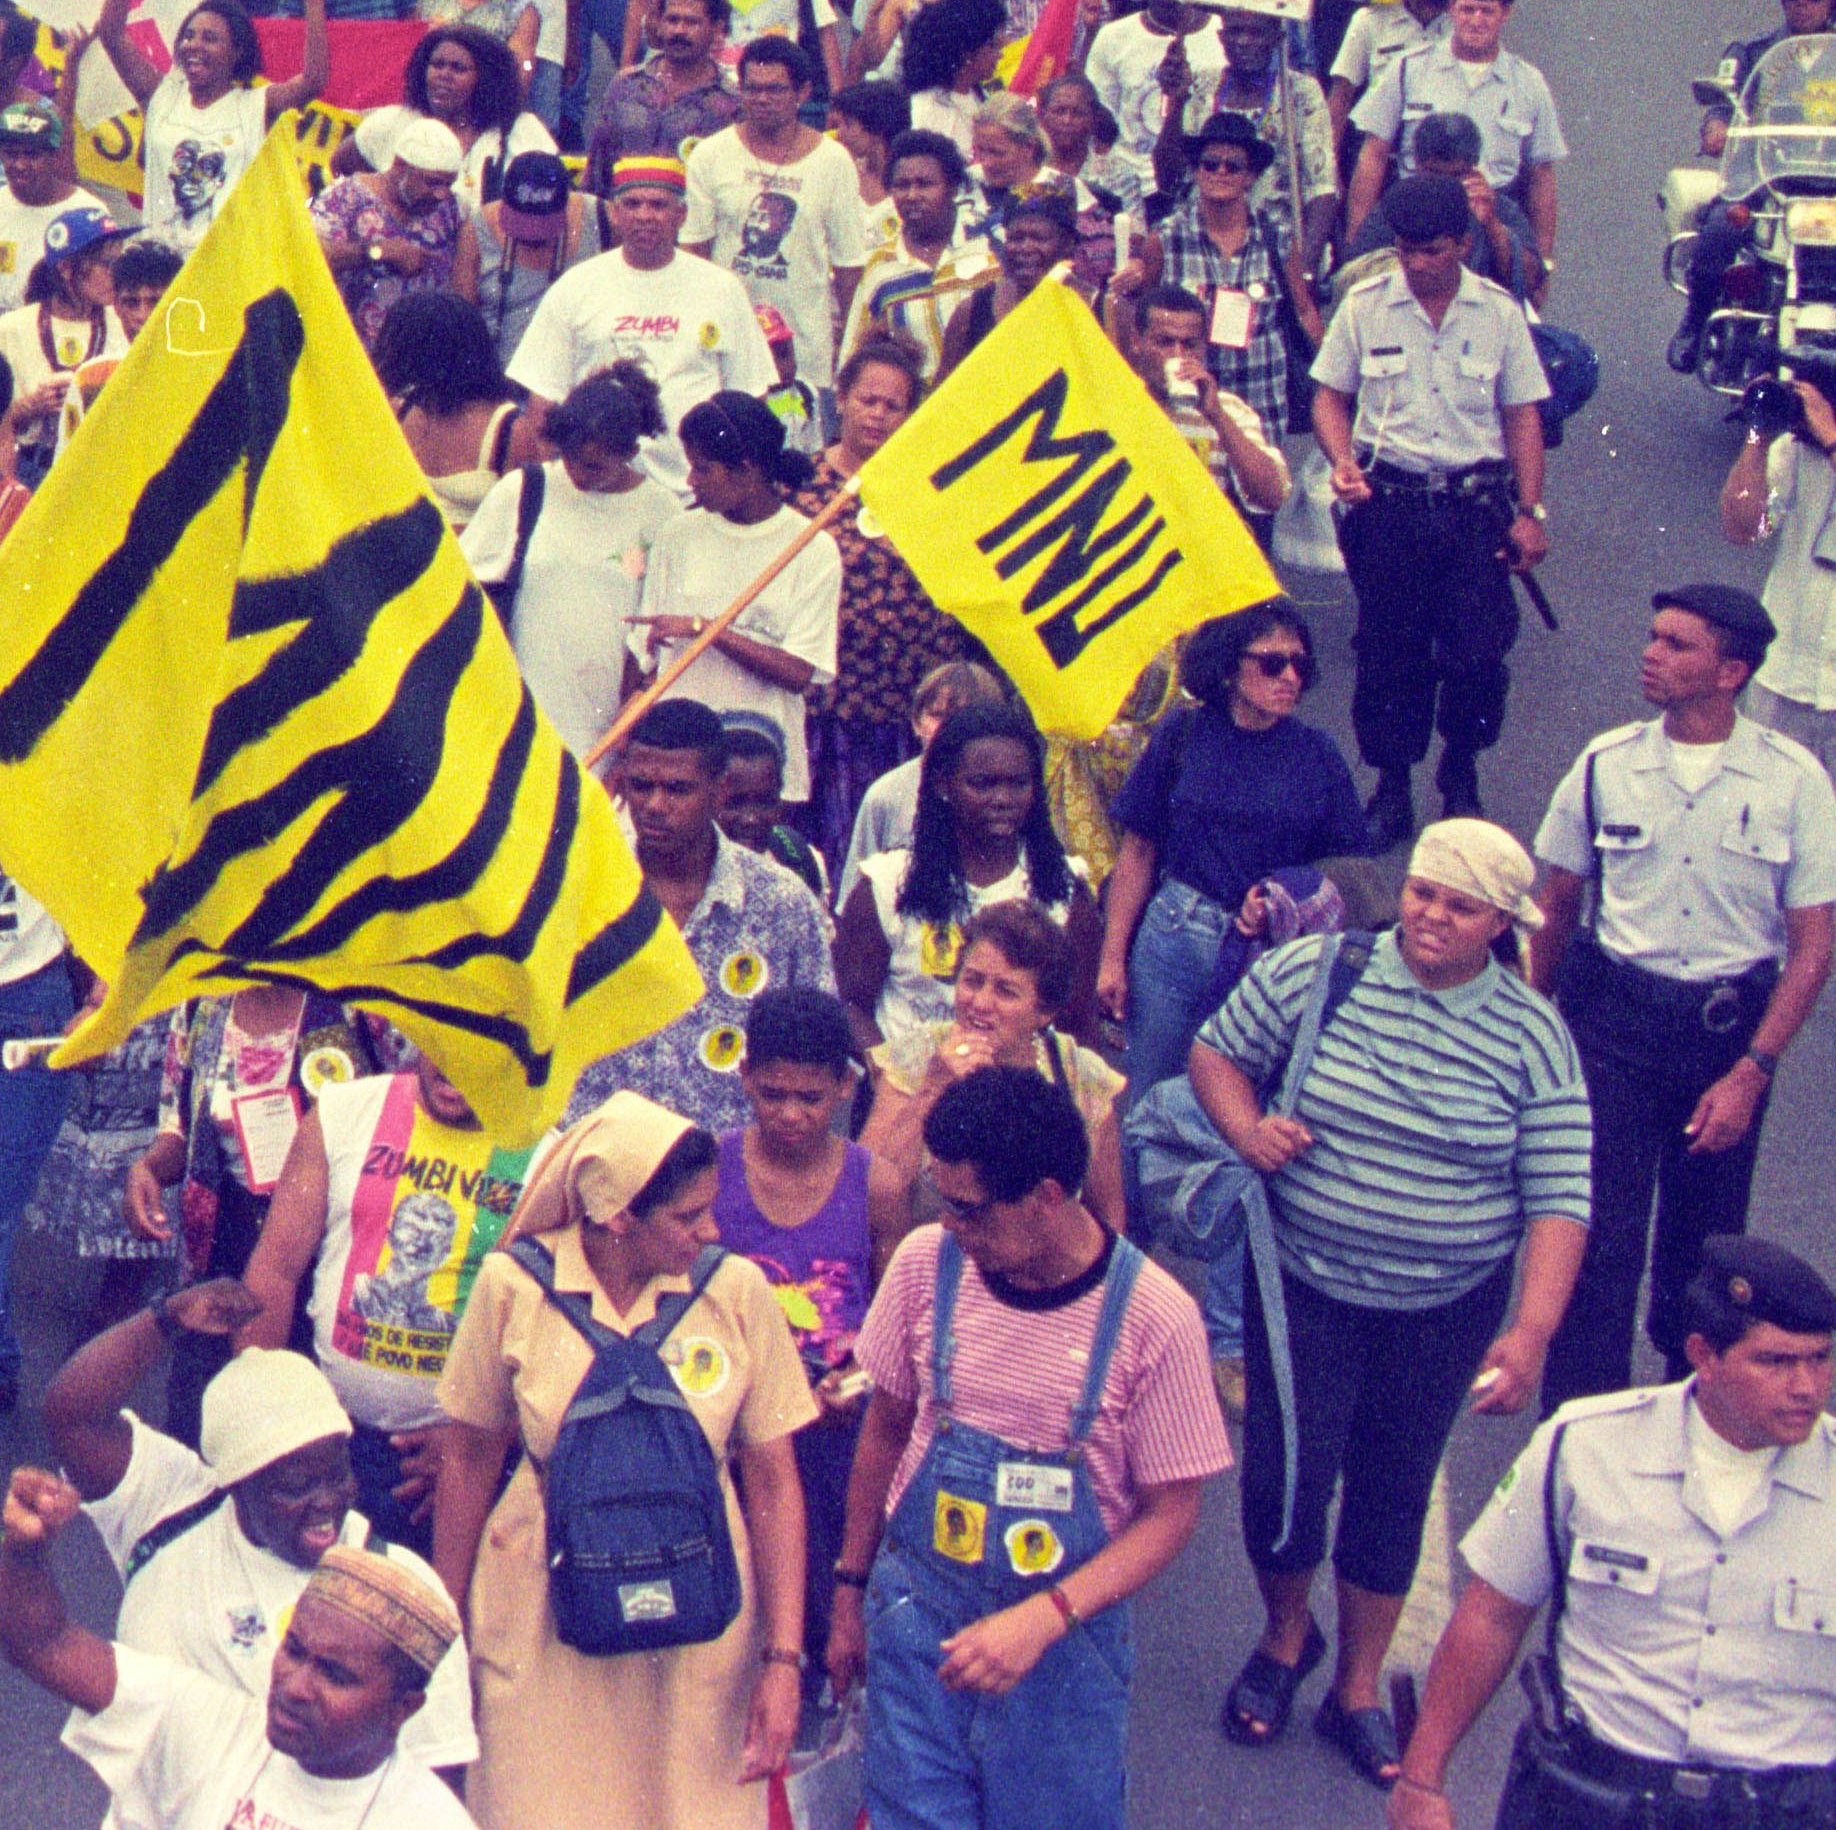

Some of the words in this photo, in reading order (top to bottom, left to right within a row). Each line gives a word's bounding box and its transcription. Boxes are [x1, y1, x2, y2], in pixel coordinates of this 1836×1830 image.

[929, 367, 1185, 671] MNU
[362, 1144, 458, 1193] ZUMBI
[407, 1330, 455, 1353] RESIST
[417, 1351, 446, 1372] NEG
